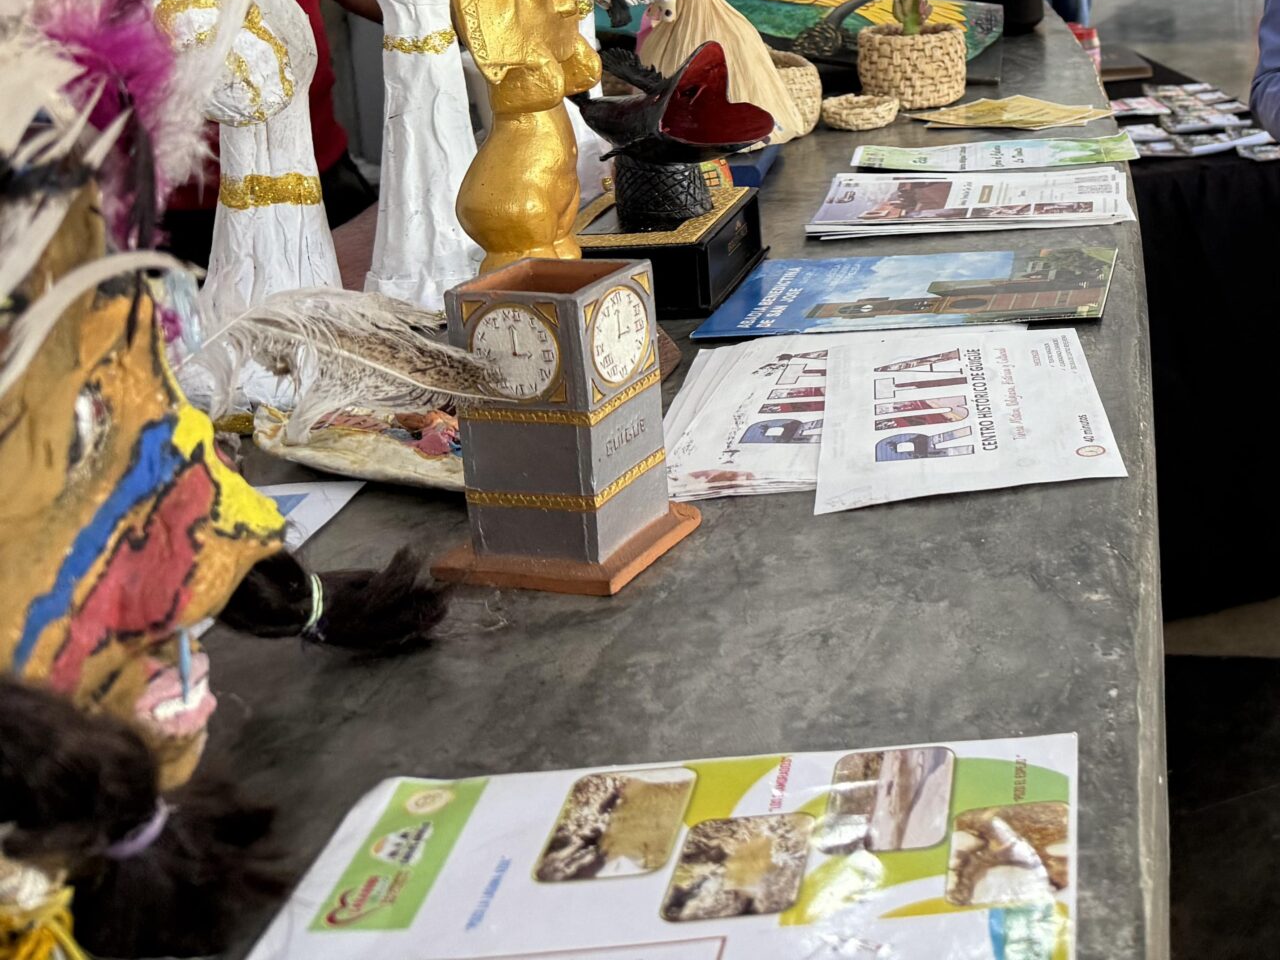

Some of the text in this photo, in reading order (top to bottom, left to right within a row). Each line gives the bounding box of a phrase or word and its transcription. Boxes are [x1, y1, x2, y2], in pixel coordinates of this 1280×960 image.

[971, 373, 986, 381] DE
[874, 348, 975, 462] RUTA
[971, 382, 993, 419] HISTÓRICO
[979, 421, 998, 451] CENTRO
